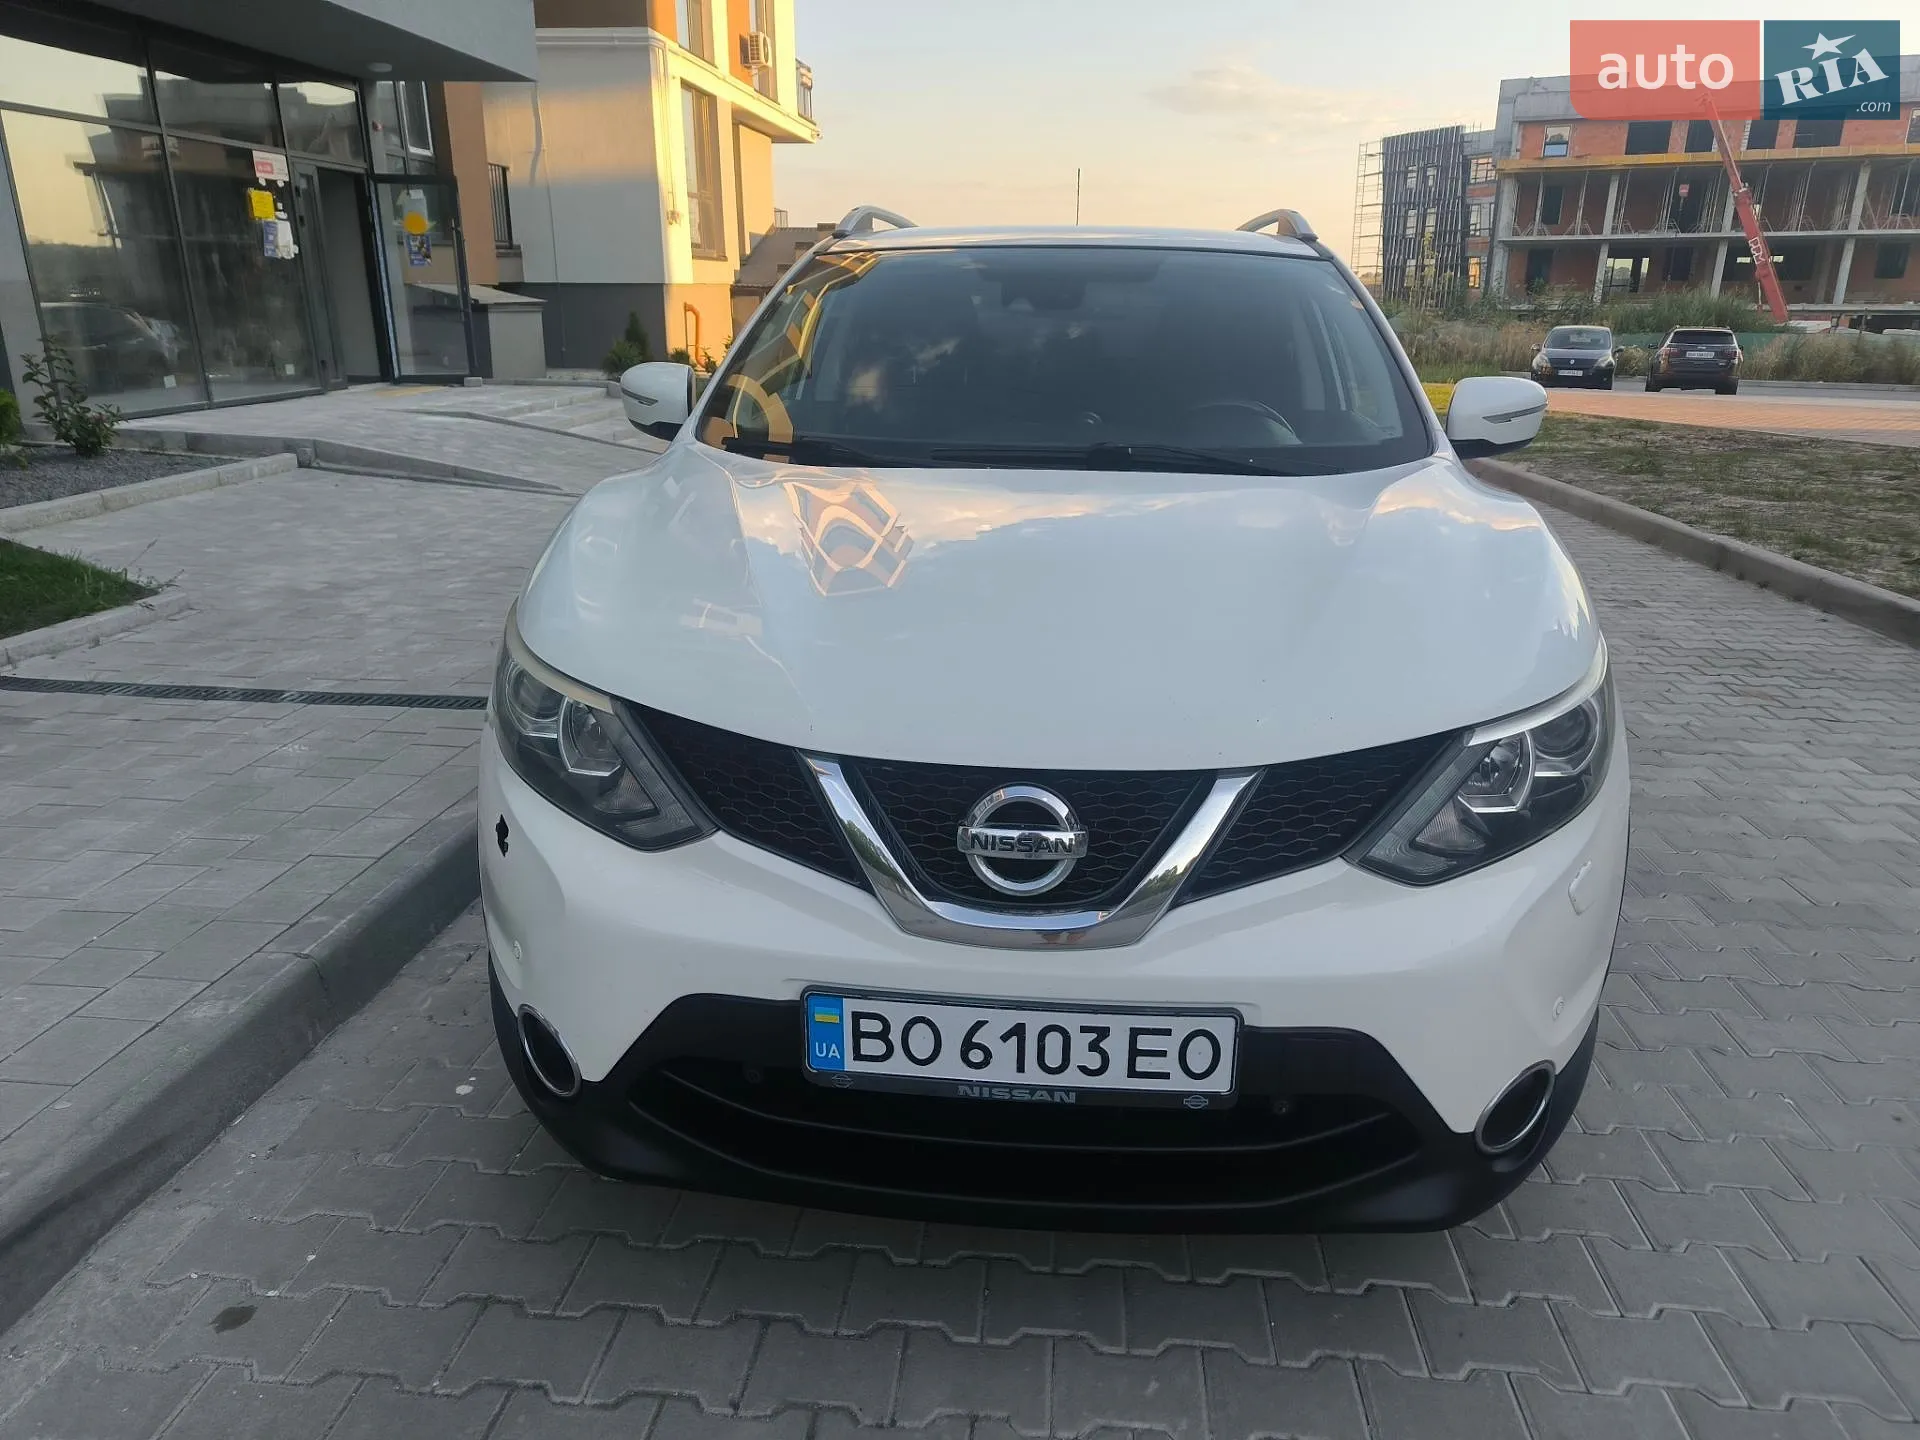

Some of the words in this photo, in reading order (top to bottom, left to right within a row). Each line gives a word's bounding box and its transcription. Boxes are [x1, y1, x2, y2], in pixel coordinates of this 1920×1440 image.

[970, 833, 1074, 854] NISSAN
[815, 1042, 841, 1060] UA
[850, 1010, 943, 1067] BO
[959, 1019, 1111, 1078] 6103
[1126, 1026, 1221, 1081] EO
[957, 1084, 1076, 1104] NISSAN
